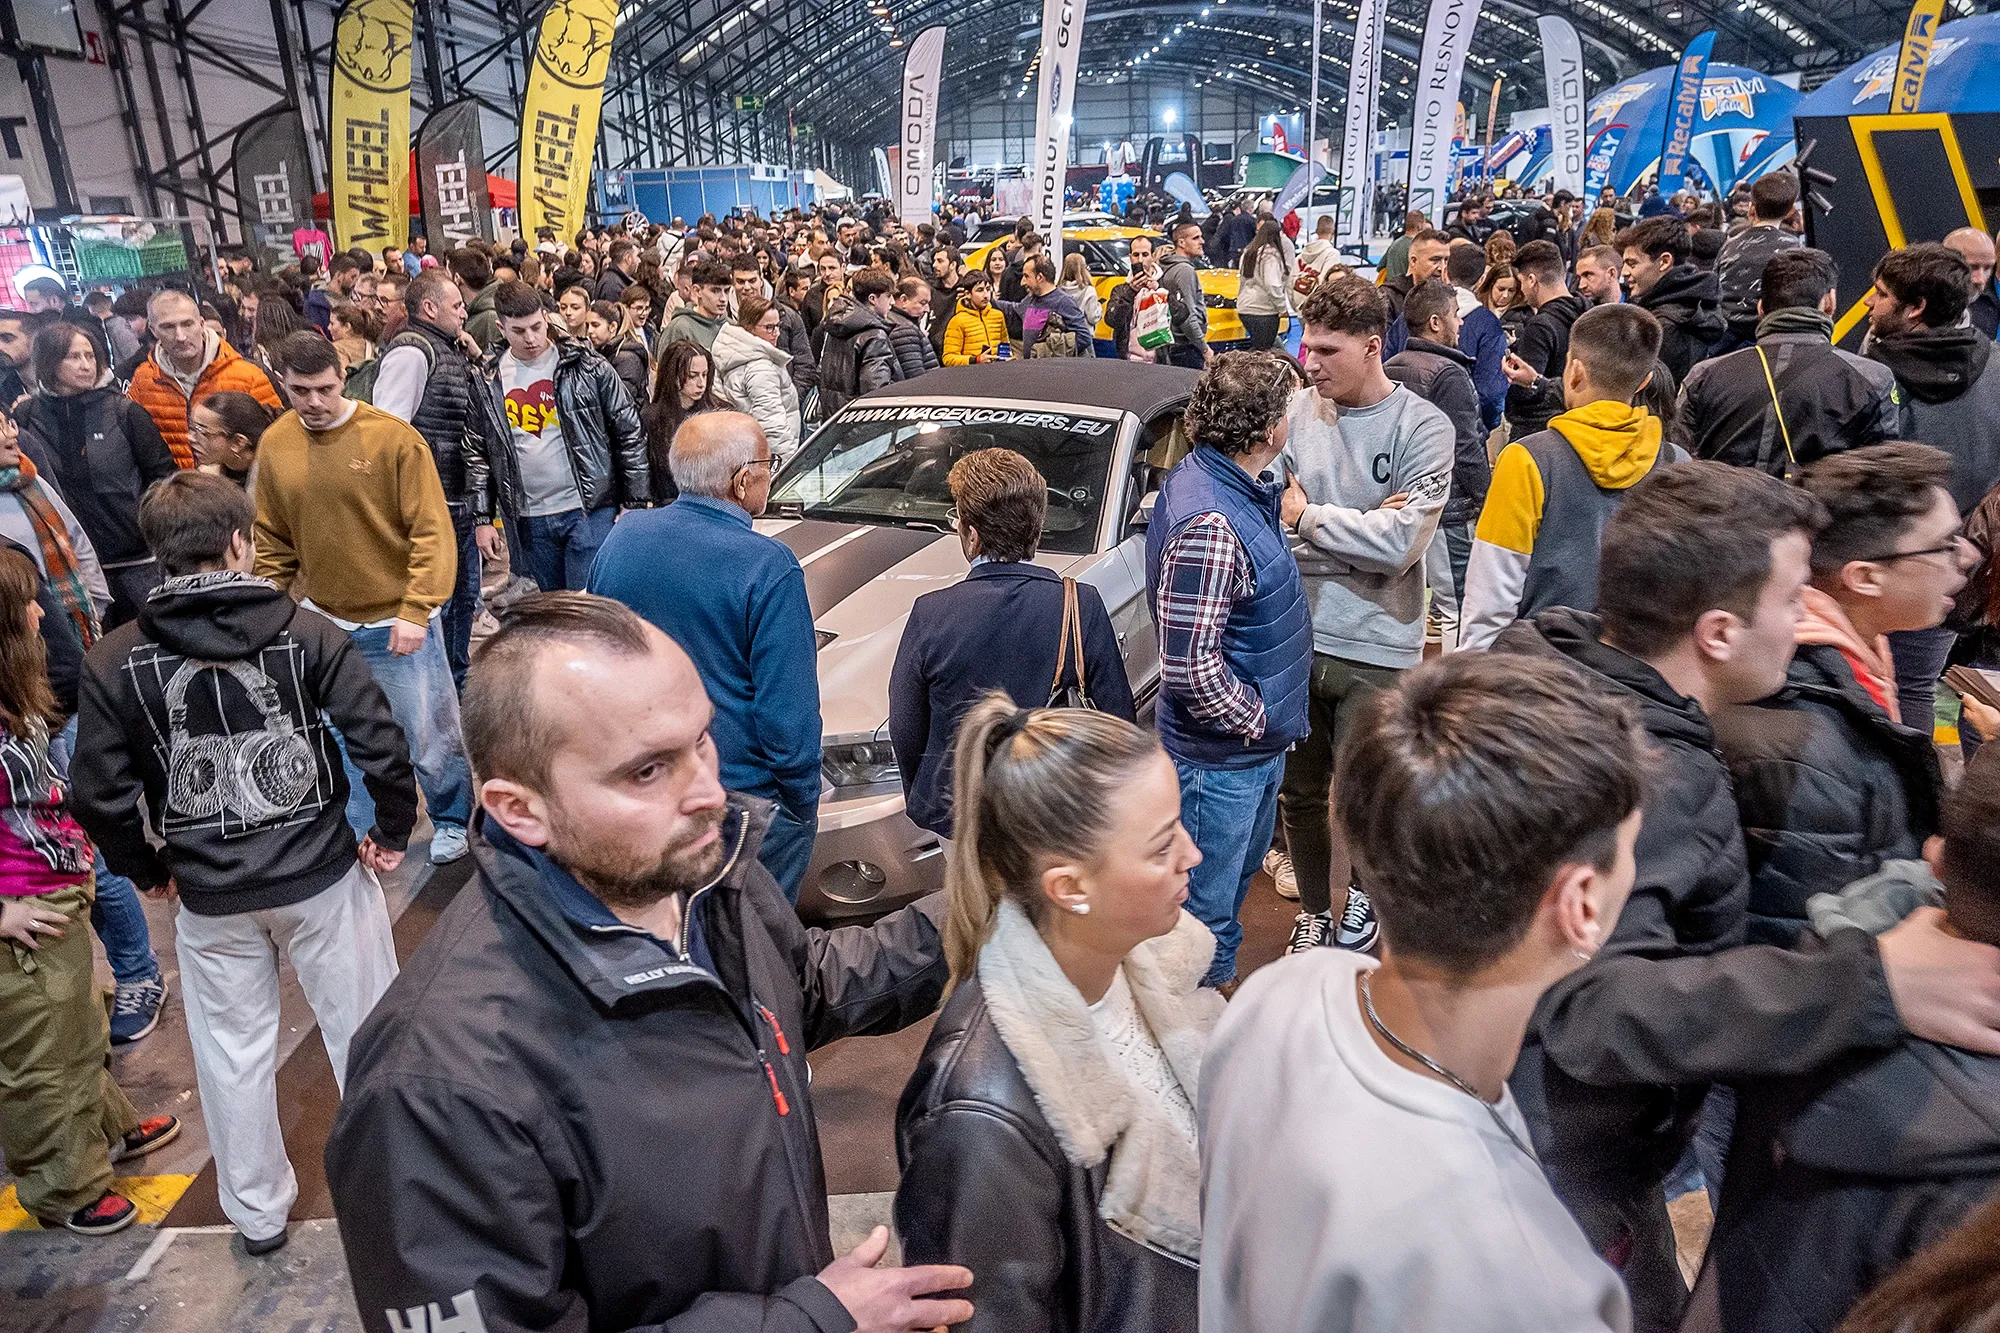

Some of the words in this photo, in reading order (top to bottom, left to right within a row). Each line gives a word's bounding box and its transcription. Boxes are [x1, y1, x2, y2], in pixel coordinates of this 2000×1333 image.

[906, 73, 925, 196] OMODA
[1416, 100, 1442, 182] GRUPO
[1668, 75, 1699, 157] Recalvi
[346, 108, 390, 242] WHEEL
[534, 104, 580, 233] WHEEL
[504, 397, 560, 432] SEX
[836, 406, 1112, 437] WWW.WAGENCOVERS.EU
[1372, 452, 1391, 485] C
